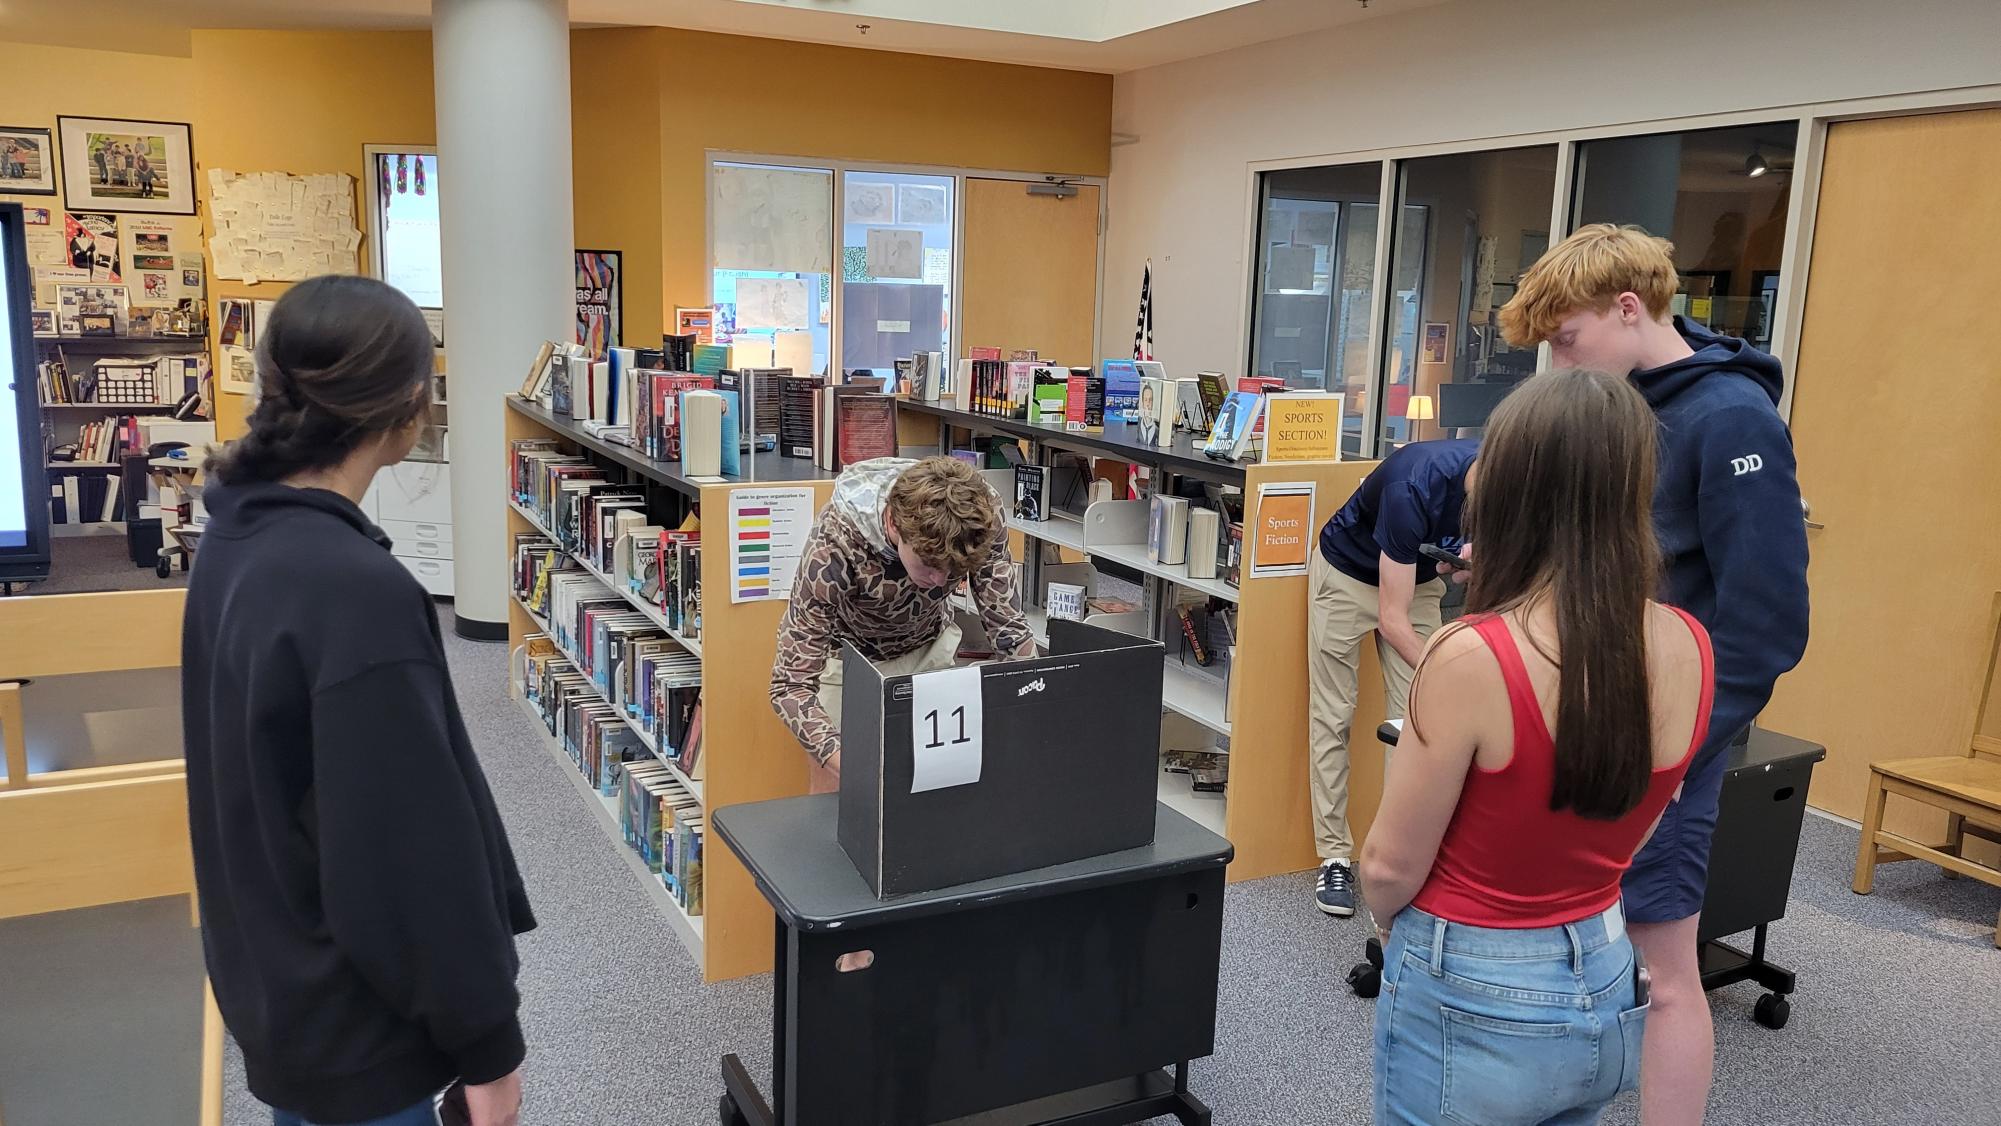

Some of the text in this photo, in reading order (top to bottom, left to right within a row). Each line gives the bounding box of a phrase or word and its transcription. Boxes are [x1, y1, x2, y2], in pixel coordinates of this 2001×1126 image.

[576, 288, 608, 301] as all
[576, 303, 609, 315] ream.
[1296, 400, 1315, 408] NEW!
[1284, 412, 1324, 424] SPORTS
[661, 425, 680, 439] DE
[1278, 430, 1327, 441] SECTION!
[1730, 453, 1763, 476] DD
[1268, 516, 1299, 530] Sports
[1265, 533, 1299, 545] Fiction
[1053, 591, 1075, 604] GAME
[1017, 677, 1046, 697] Pacon
[924, 704, 971, 749] 11
